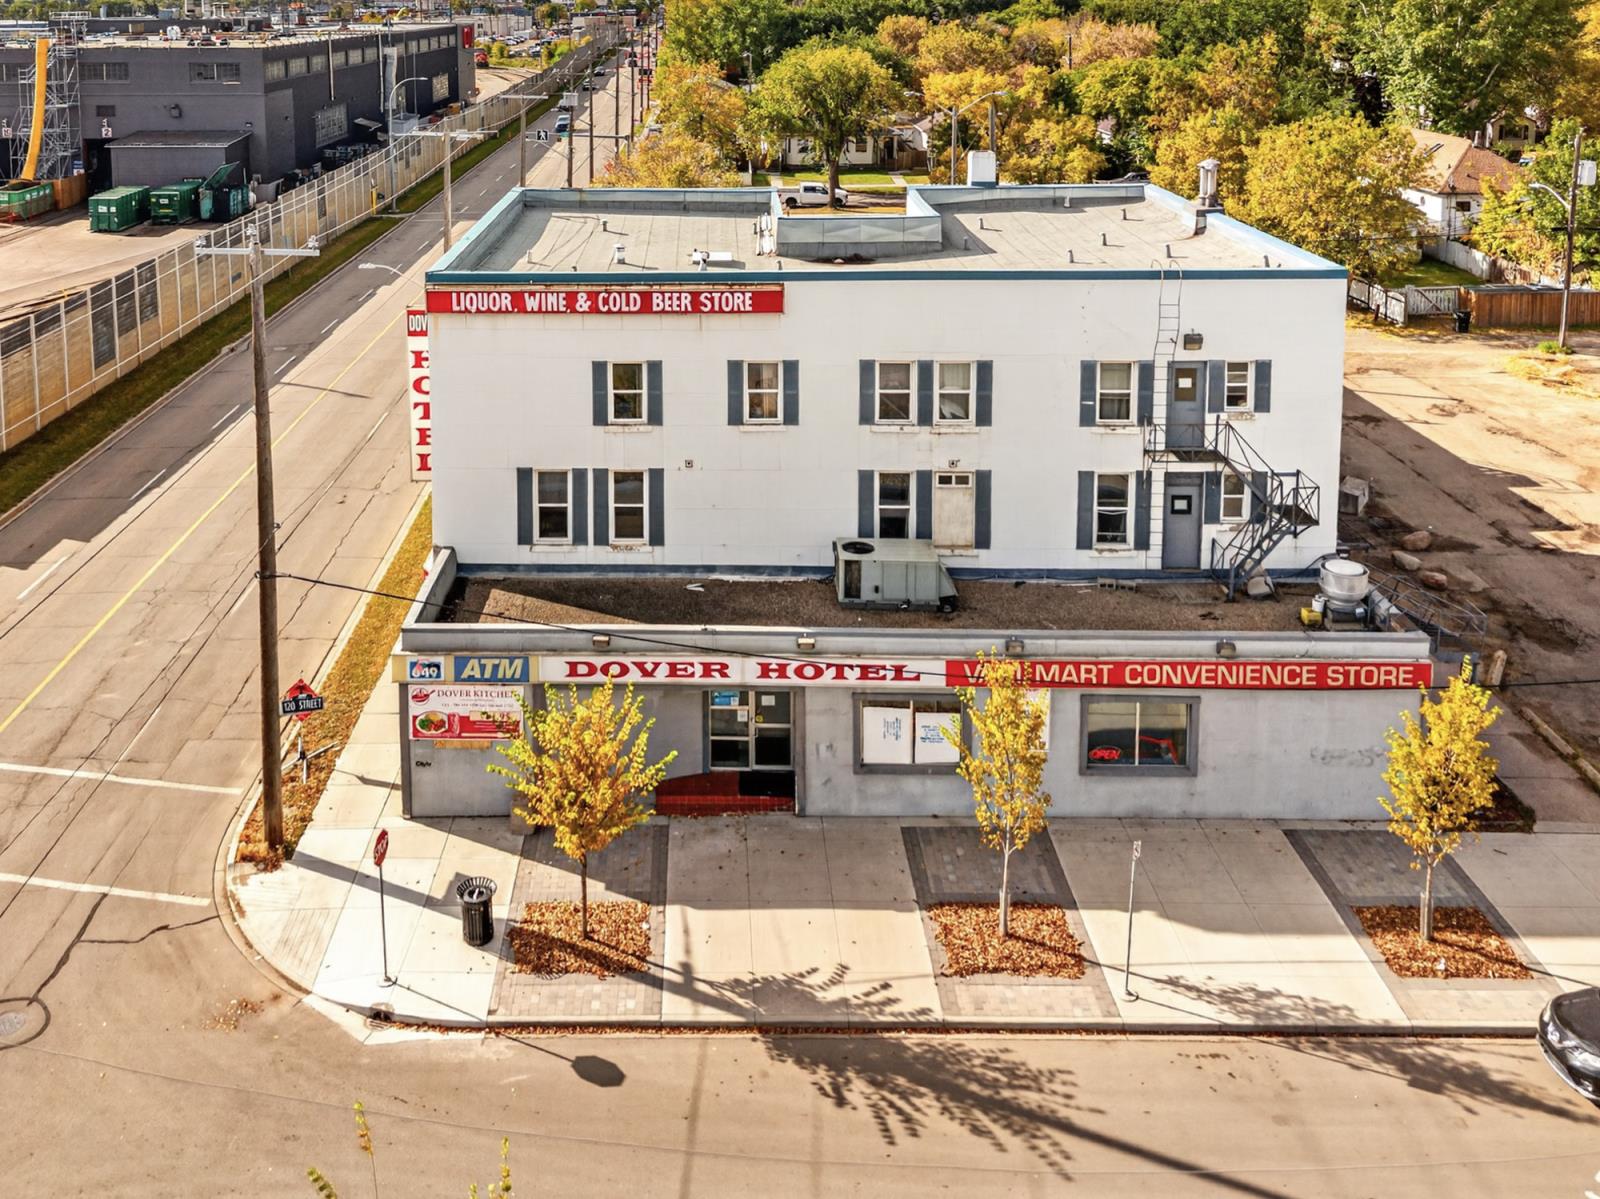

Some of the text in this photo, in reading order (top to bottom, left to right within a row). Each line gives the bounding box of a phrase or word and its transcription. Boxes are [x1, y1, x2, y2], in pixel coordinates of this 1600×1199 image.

[575, 292, 592, 312] &
[598, 292, 641, 312] COLD
[652, 292, 692, 312] BEER
[700, 292, 753, 312] STORE
[460, 658, 523, 679] ATM
[565, 661, 920, 682] DOVER HOTEL
[1036, 664, 1113, 685] MART
[1125, 665, 1317, 685] CONVENIENCE
[1327, 666, 1414, 686] STORE
[437, 689, 471, 698] DOVER
[284, 698, 321, 711] 120 STREET
[374, 835, 388, 862] STOP
